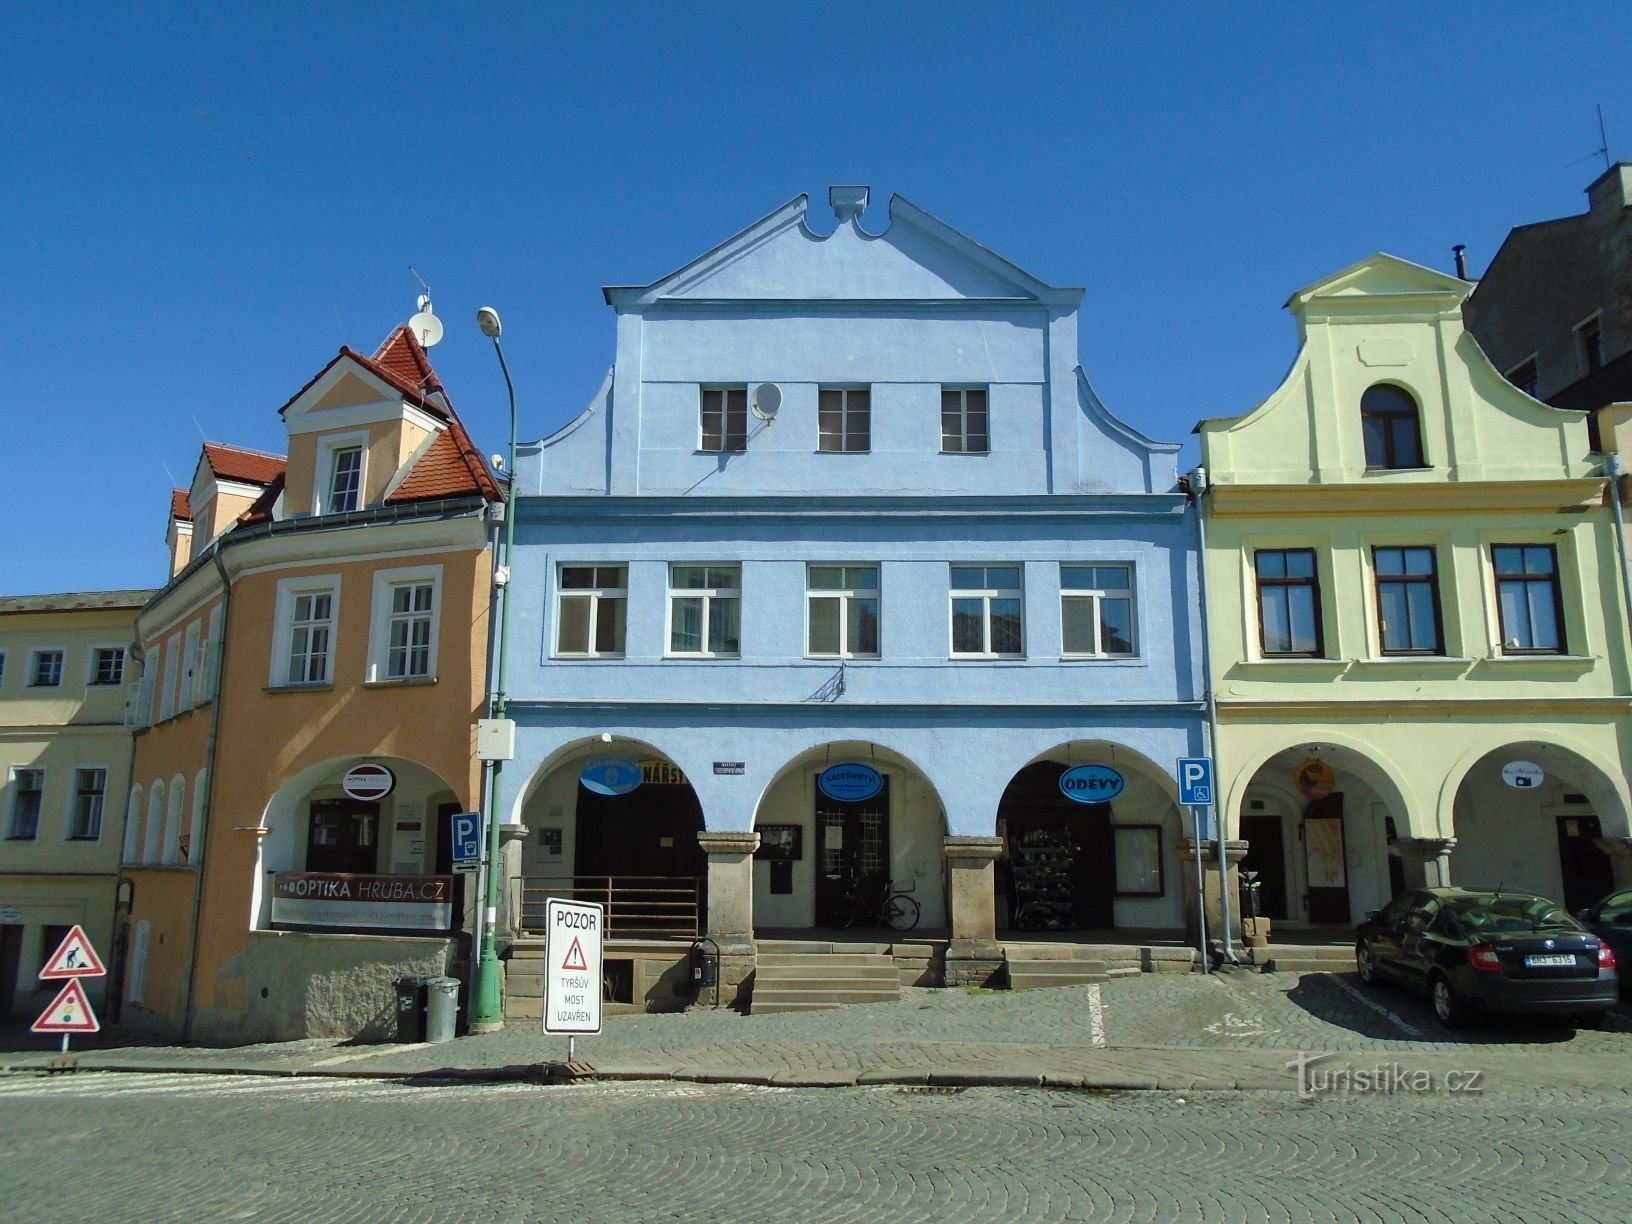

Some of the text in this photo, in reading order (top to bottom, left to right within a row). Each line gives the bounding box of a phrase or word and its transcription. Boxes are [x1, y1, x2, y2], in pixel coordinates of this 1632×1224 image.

[1065, 775, 1120, 790] ODĚVY
[1185, 764, 1204, 790] P
[457, 819, 473, 846] P
[296, 880, 351, 897] OPTIKA
[557, 910, 597, 931] POZOR
[564, 995, 585, 1005] MOST
[557, 1009, 591, 1022] UZAVŘEN
